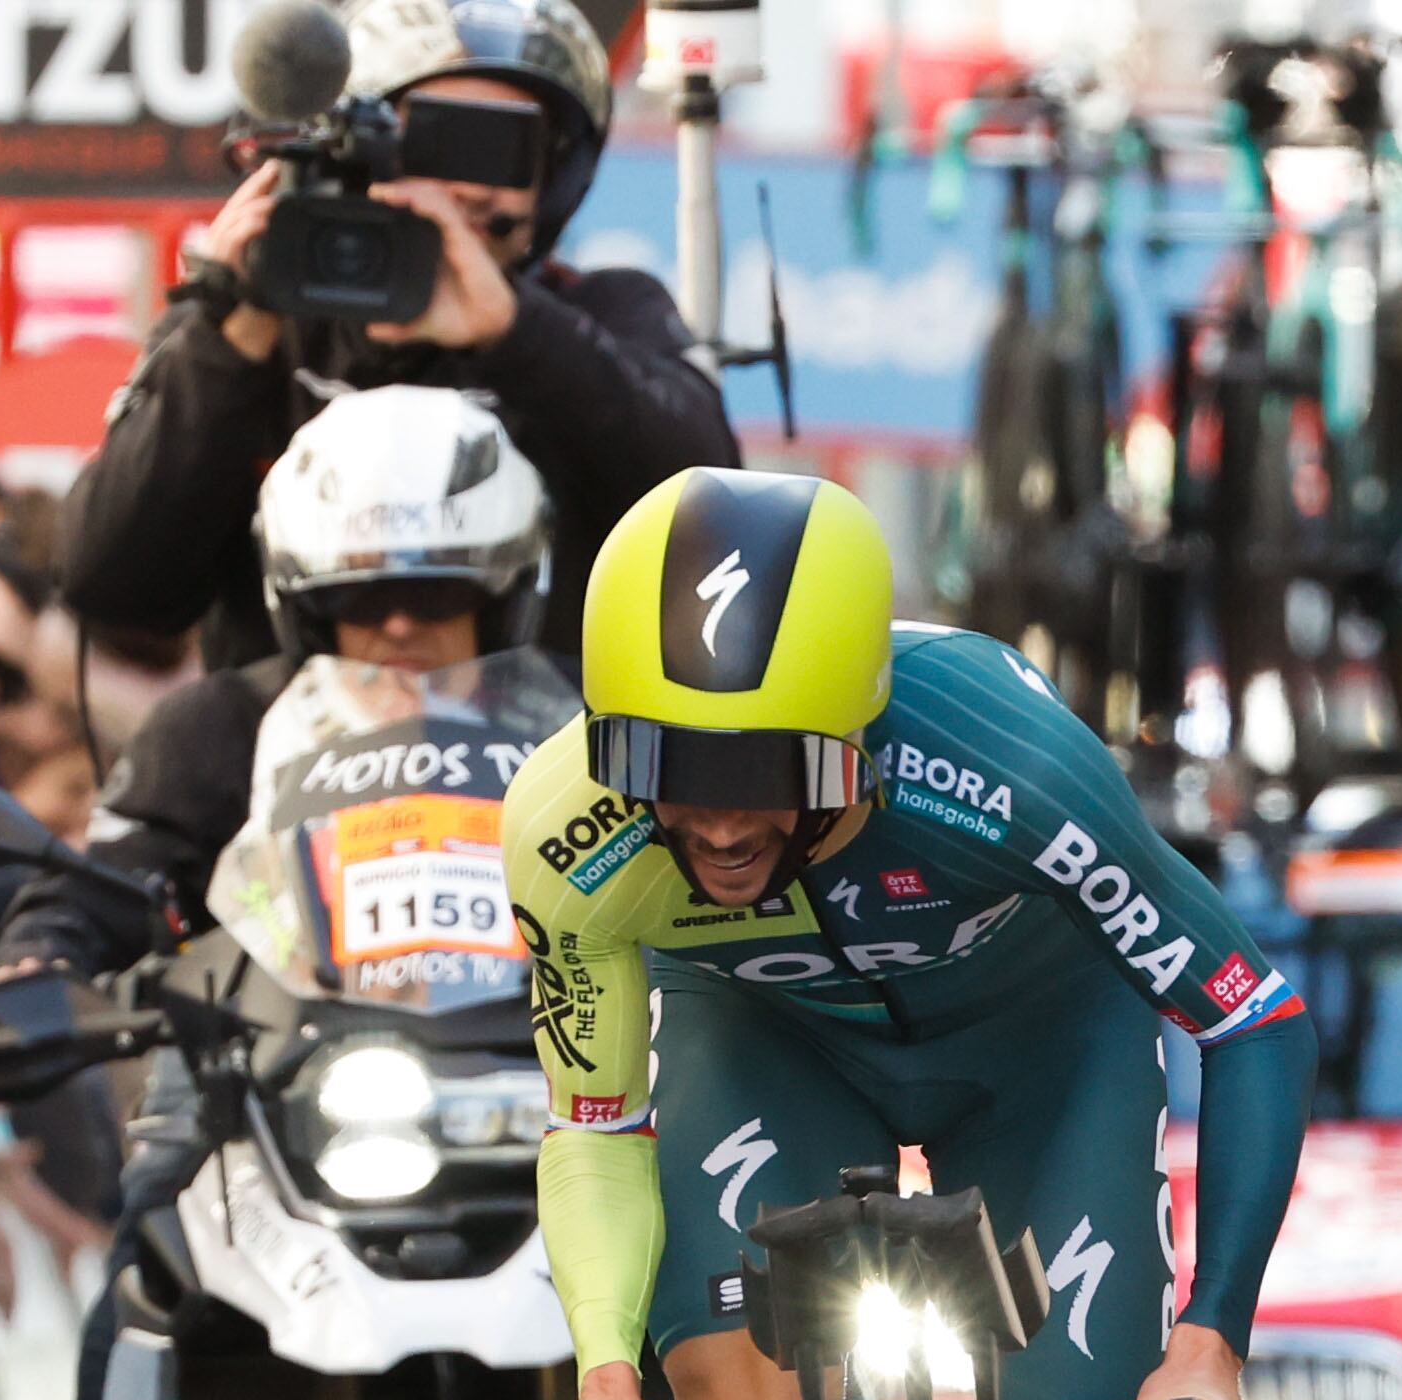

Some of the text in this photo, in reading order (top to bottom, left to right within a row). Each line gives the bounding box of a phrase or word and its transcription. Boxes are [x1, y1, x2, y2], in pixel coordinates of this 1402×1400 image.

[300, 742, 472, 793] MOTOS
[897, 743, 1012, 822] BORA
[897, 783, 1001, 841] hansgrohe
[569, 818, 655, 890] hansgroh
[887, 875, 917, 886] ÖTZ
[891, 885, 923, 895] TAL
[364, 891, 497, 932] 1159
[672, 910, 746, 928] GRENKE
[1032, 820, 1196, 995] BORA
[690, 892, 1022, 984] ORA
[360, 951, 465, 991] MOTOS
[570, 966, 595, 1005] FLEX
[1213, 962, 1245, 997] ÖTZ
[1222, 978, 1254, 1006] TAL
[575, 1008, 596, 1041] THE
